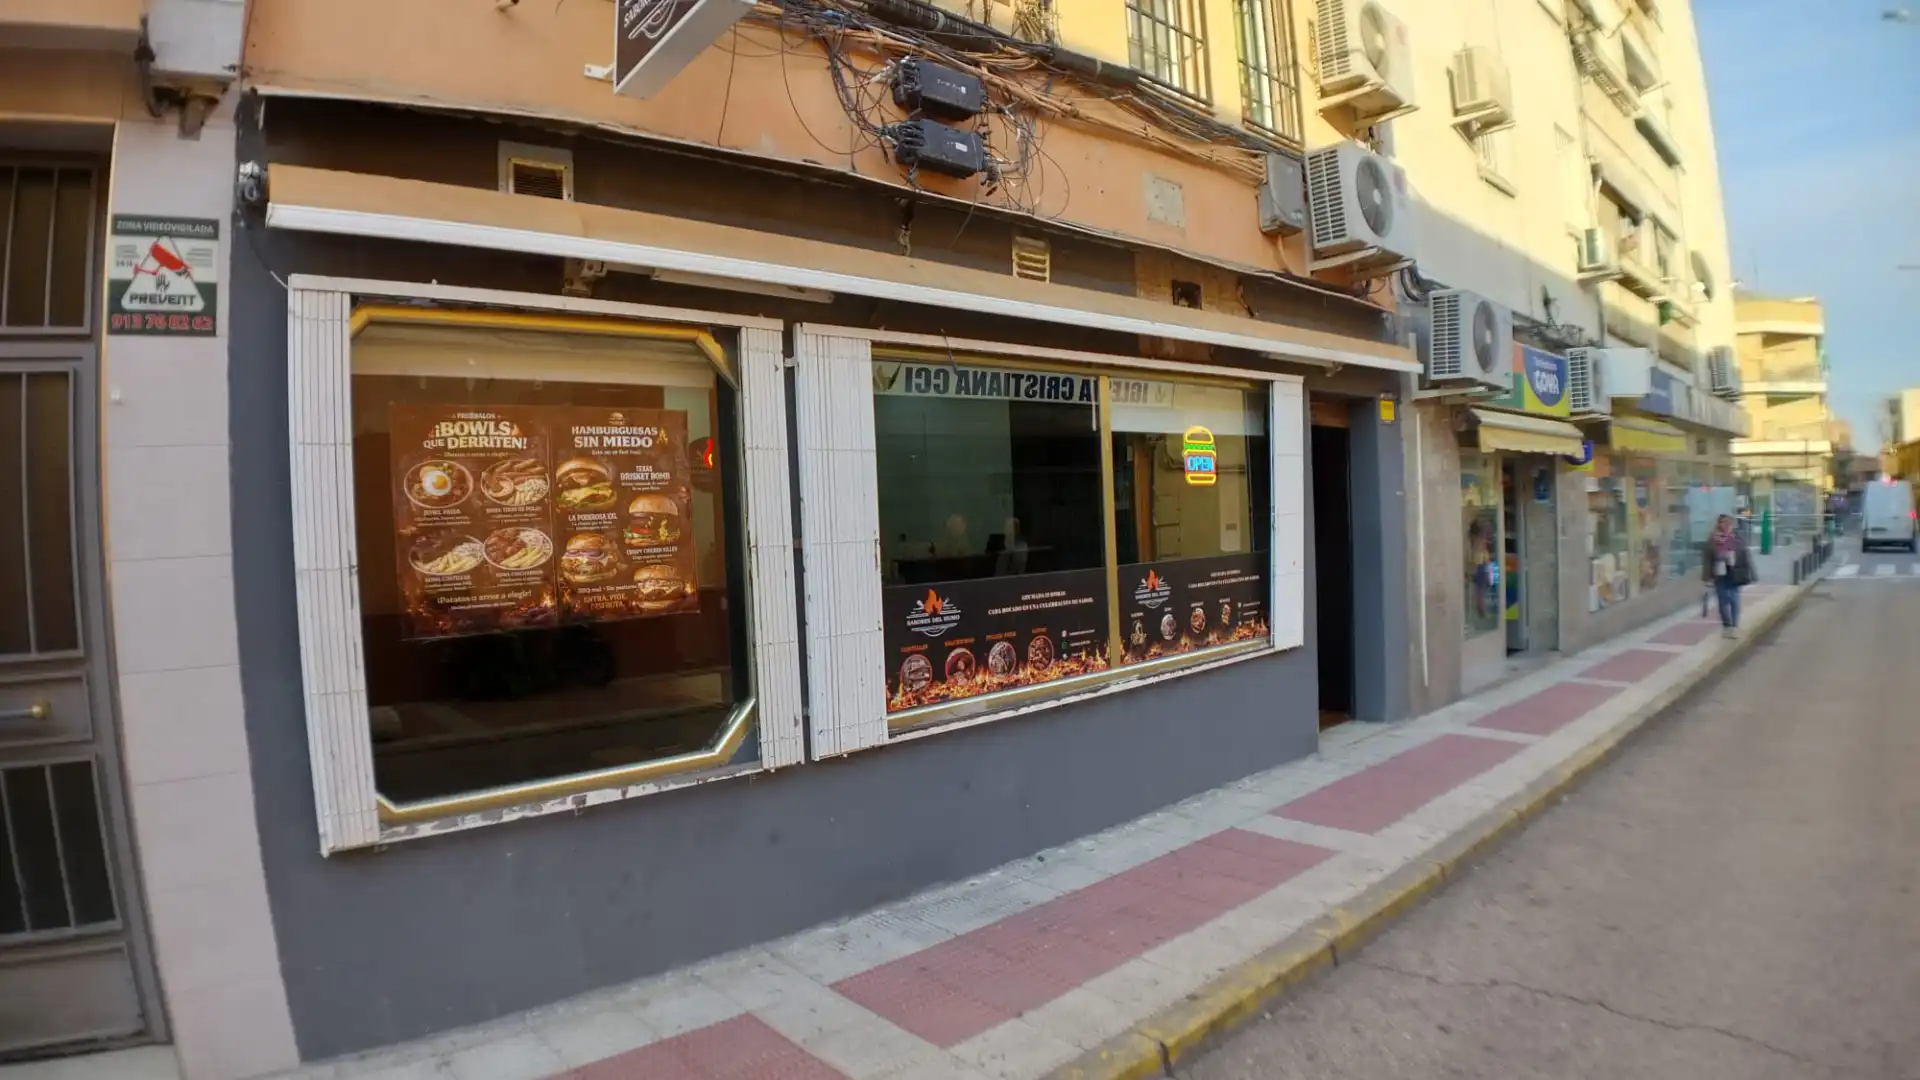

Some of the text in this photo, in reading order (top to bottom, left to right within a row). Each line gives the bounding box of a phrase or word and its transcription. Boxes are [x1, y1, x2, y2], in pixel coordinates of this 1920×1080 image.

[116, 220, 214, 233] ZONA VIDEOVIGILADA
[129, 293, 196, 305] PREVENT
[571, 426, 658, 435] HAMBURGUESAS
[423, 436, 528, 449] QUE DERRITEN!
[574, 437, 653, 448] SIN MIEDO
[1188, 456, 1214, 472] OPEN
